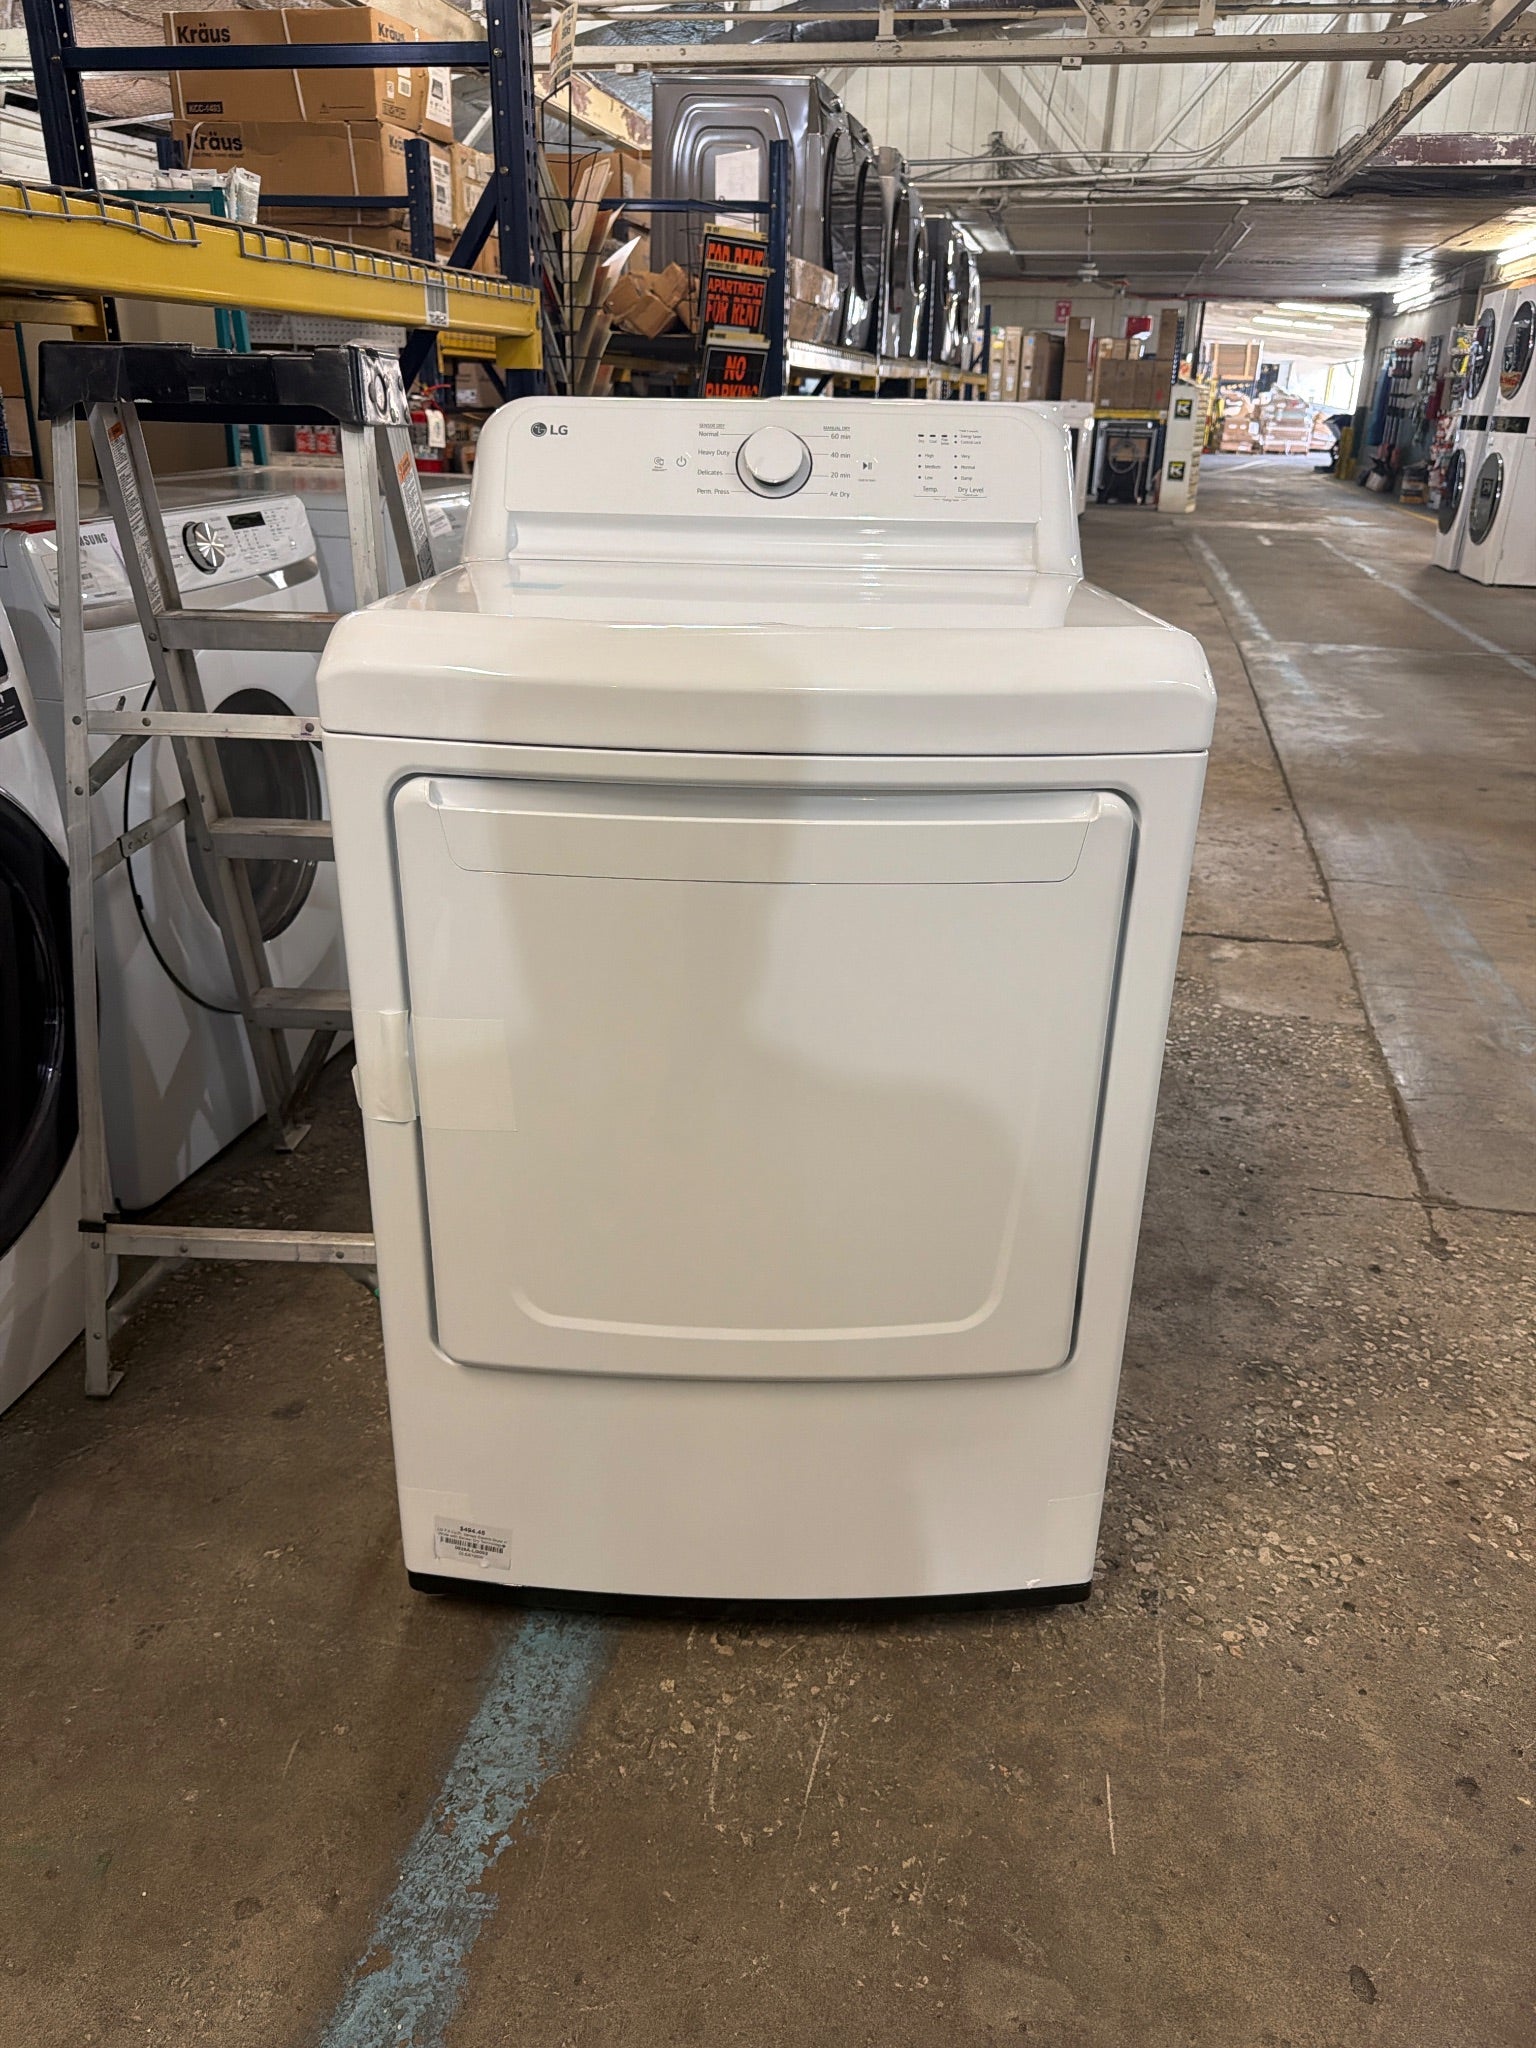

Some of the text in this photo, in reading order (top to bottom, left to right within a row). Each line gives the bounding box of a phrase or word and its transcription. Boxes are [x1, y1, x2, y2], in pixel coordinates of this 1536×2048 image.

[176, 22, 231, 43] Kräus
[186, 131, 243, 151] Kräus
[707, 277, 765, 298] APARTMENT
[705, 294, 762, 327] FOR RENT
[724, 355, 748, 380] NO
[549, 424, 569, 436] LG
[840, 491, 850, 499] Dry
[958, 486, 968, 494] Dry
